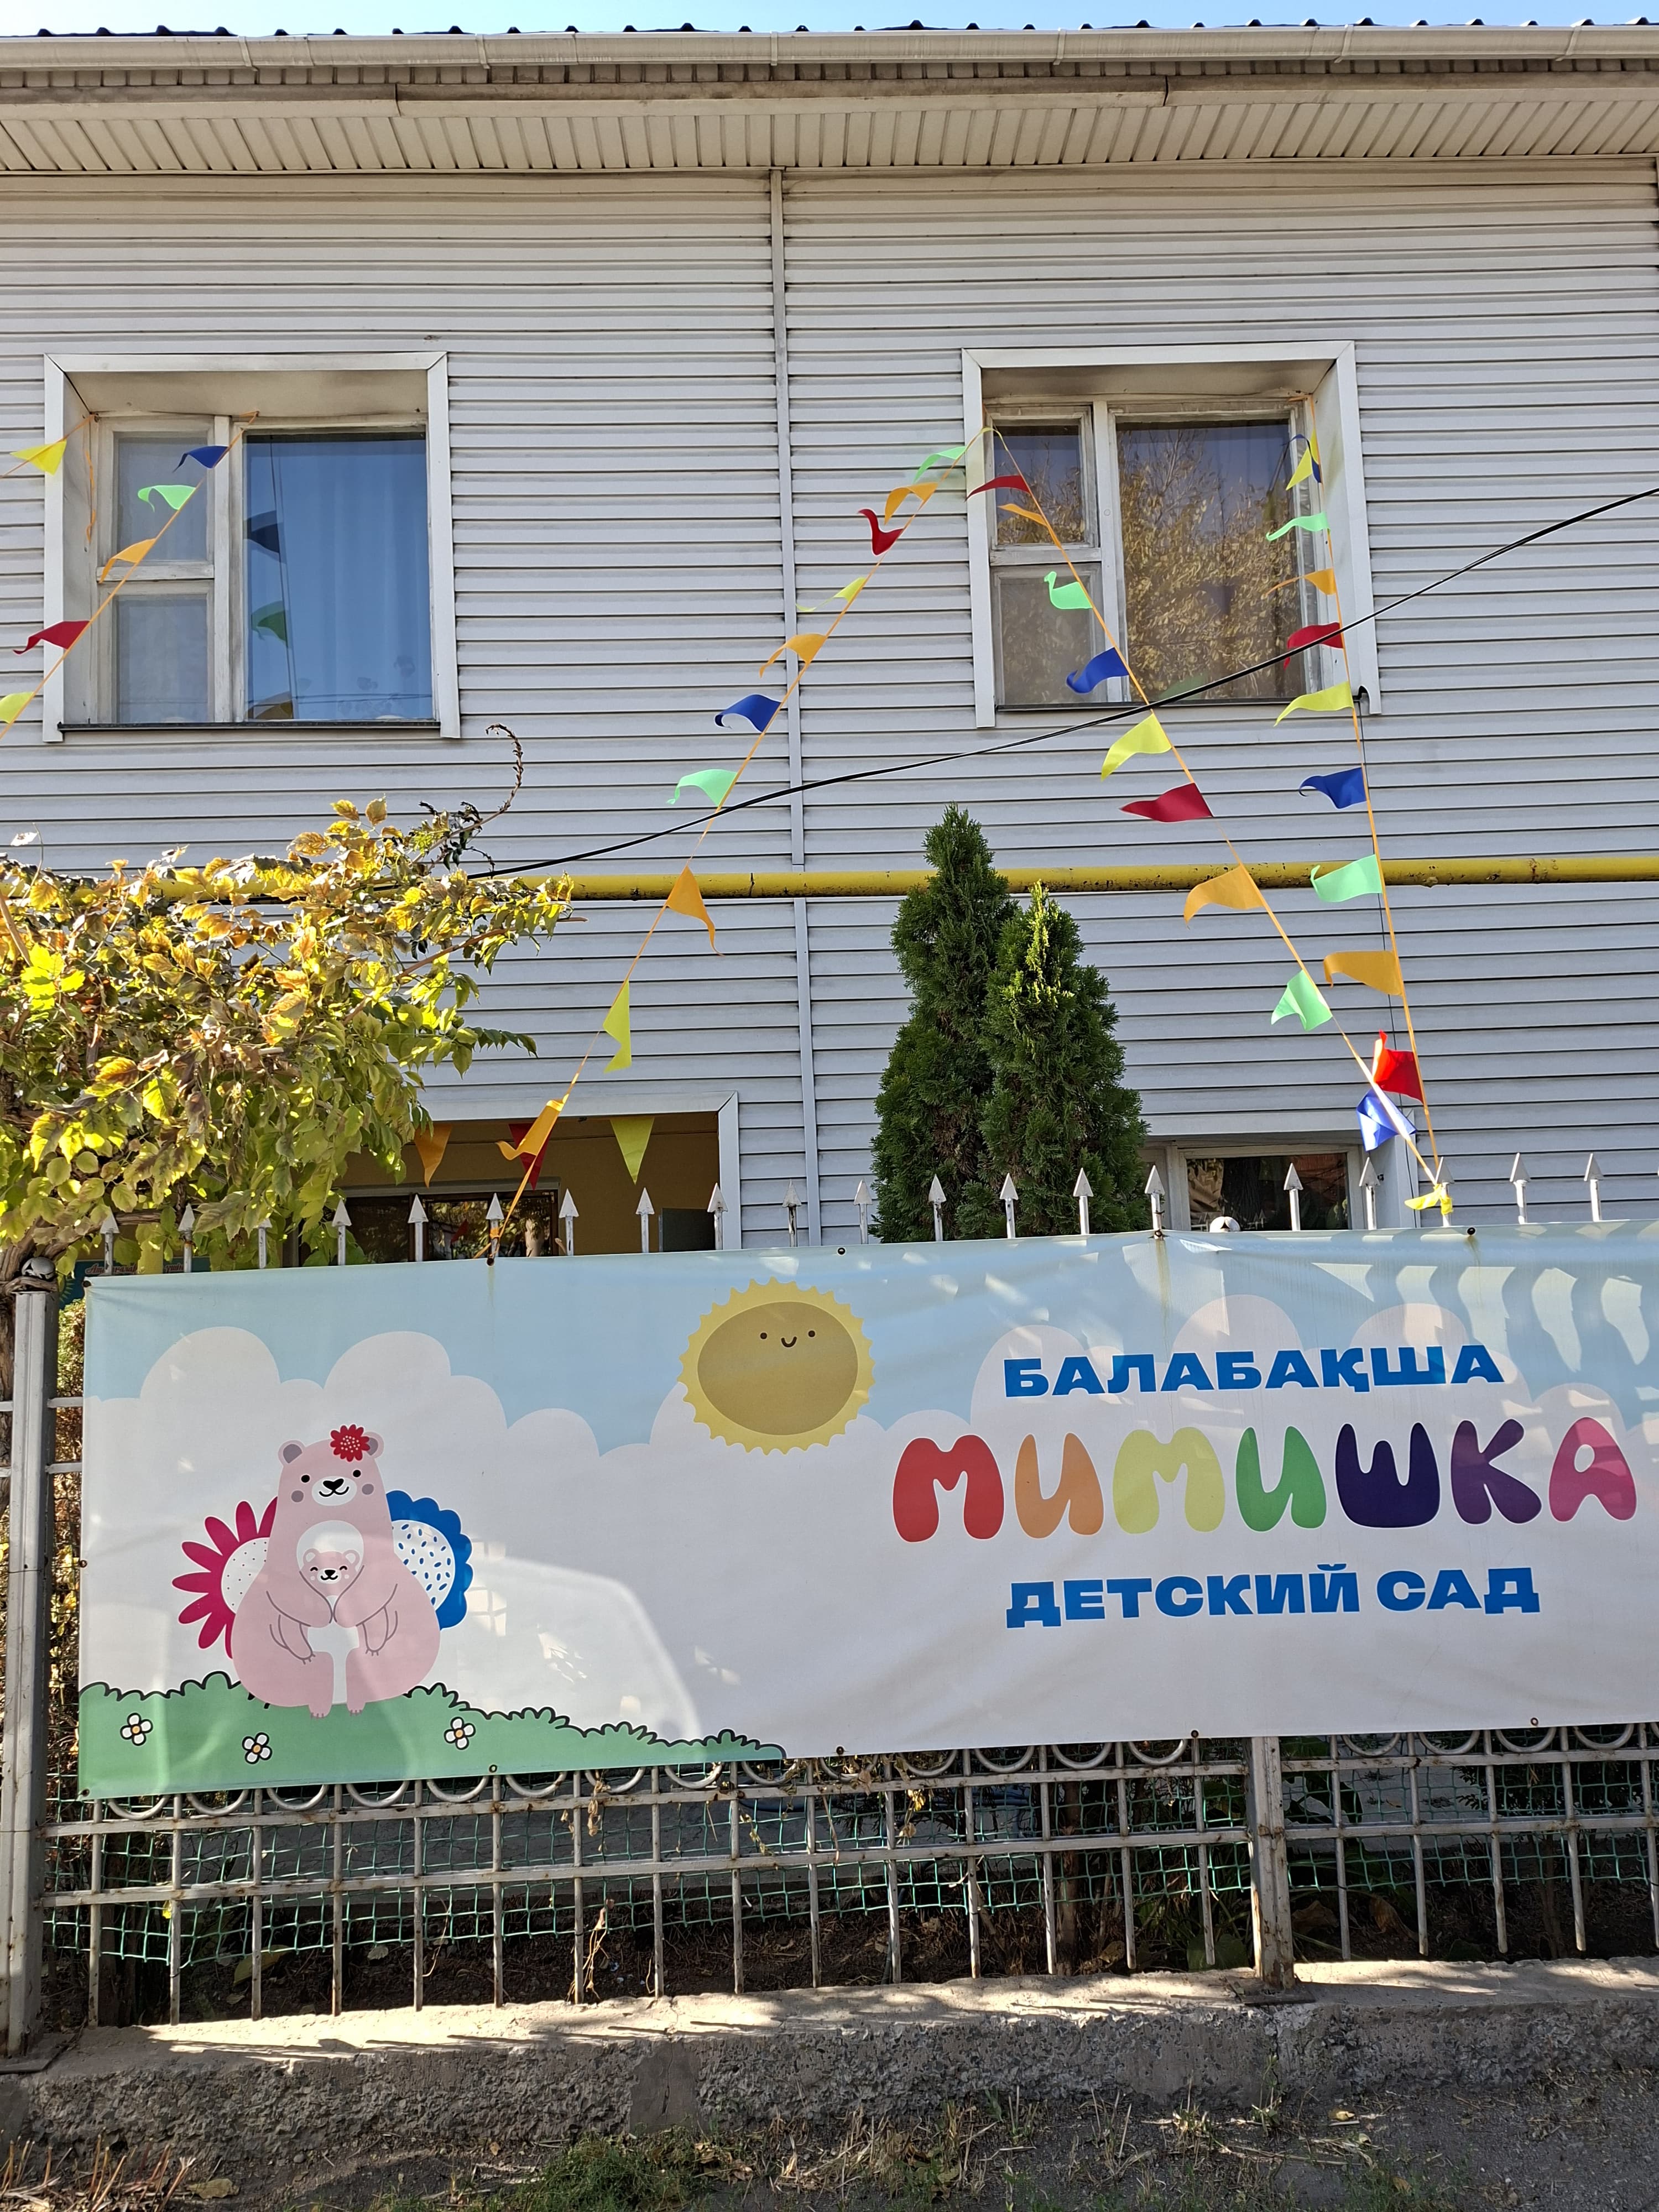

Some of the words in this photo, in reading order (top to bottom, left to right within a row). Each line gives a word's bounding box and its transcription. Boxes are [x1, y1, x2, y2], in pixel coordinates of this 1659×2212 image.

[1004, 1345, 1505, 1397] БАЛАБАҚША
[892, 1416, 1637, 1543] МИМИШКА
[1005, 1563, 1360, 1629] ДЕТСКИЙ
[1376, 1567, 1541, 1614] САД
